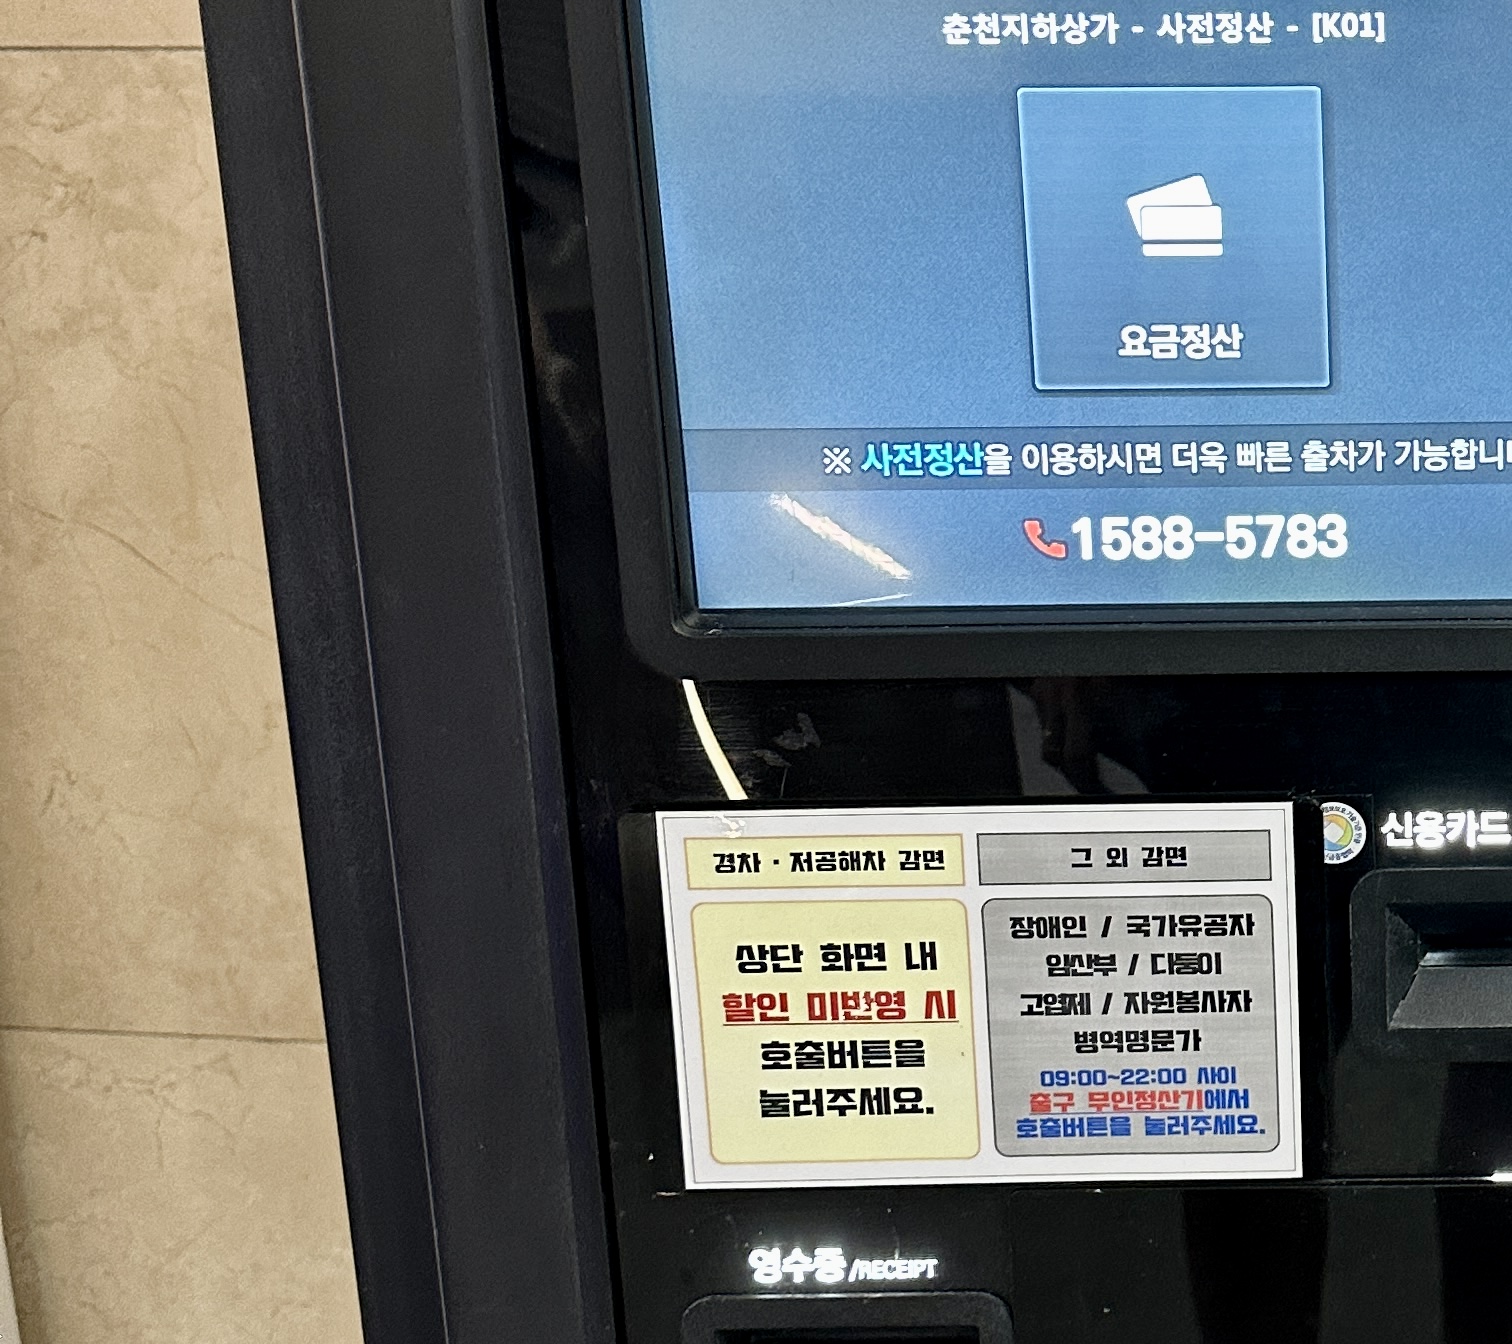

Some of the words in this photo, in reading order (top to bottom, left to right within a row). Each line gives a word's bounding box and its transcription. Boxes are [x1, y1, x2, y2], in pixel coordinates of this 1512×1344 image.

[940, 11, 1122, 48] 춘천지하상가
[1155, 10, 1275, 46] 사전정산
[1311, 9, 1388, 47] [K01]
[1117, 323, 1245, 361] 요금정산
[860, 440, 1013, 480] 사전정산을
[1020, 439, 1164, 478] 이용하시면
[1169, 439, 1229, 476] 더욱
[1235, 438, 1294, 474] 빠른
[1300, 437, 1387, 474] 출차가
[1069, 513, 1349, 563] 1588-5783
[1380, 811, 1512, 849] 신용카드
[712, 850, 762, 875] 경차
[790, 848, 887, 874] 저공해차
[898, 849, 946, 873] 감면
[1070, 846, 1094, 869] 그
[1105, 846, 1130, 869] 외
[1141, 845, 1188, 869] 감면
[1009, 915, 1088, 940] 장애인
[1126, 913, 1256, 938] 국가유공자
[735, 942, 803, 975] 상단
[820, 941, 888, 975] 화면
[904, 940, 938, 972] 내
[1045, 953, 1118, 978] 임산부
[1150, 951, 1223, 976] 다둥이
[722, 992, 791, 1024] 할인
[806, 991, 908, 1022] 미반영
[924, 989, 958, 1021] 시
[1020, 992, 1092, 1017] 고엽제
[1123, 989, 1253, 1016] 자원봉사자
[760, 1040, 926, 1071] 호출버튼을
[1073, 1028, 1203, 1054] 병역명문가
[1039, 1067, 1188, 1087] 09:00~22:00
[1197, 1065, 1238, 1086] 사이
[759, 1087, 936, 1120] 눌러주세요.
[1029, 1092, 1076, 1113] 출구
[1087, 1088, 1250, 1112] 무인정산기에서
[1015, 1116, 1132, 1140] 호출버튼을
[1144, 1113, 1267, 1138] 눌러주세요.
[747, 1247, 847, 1284] 영수증
